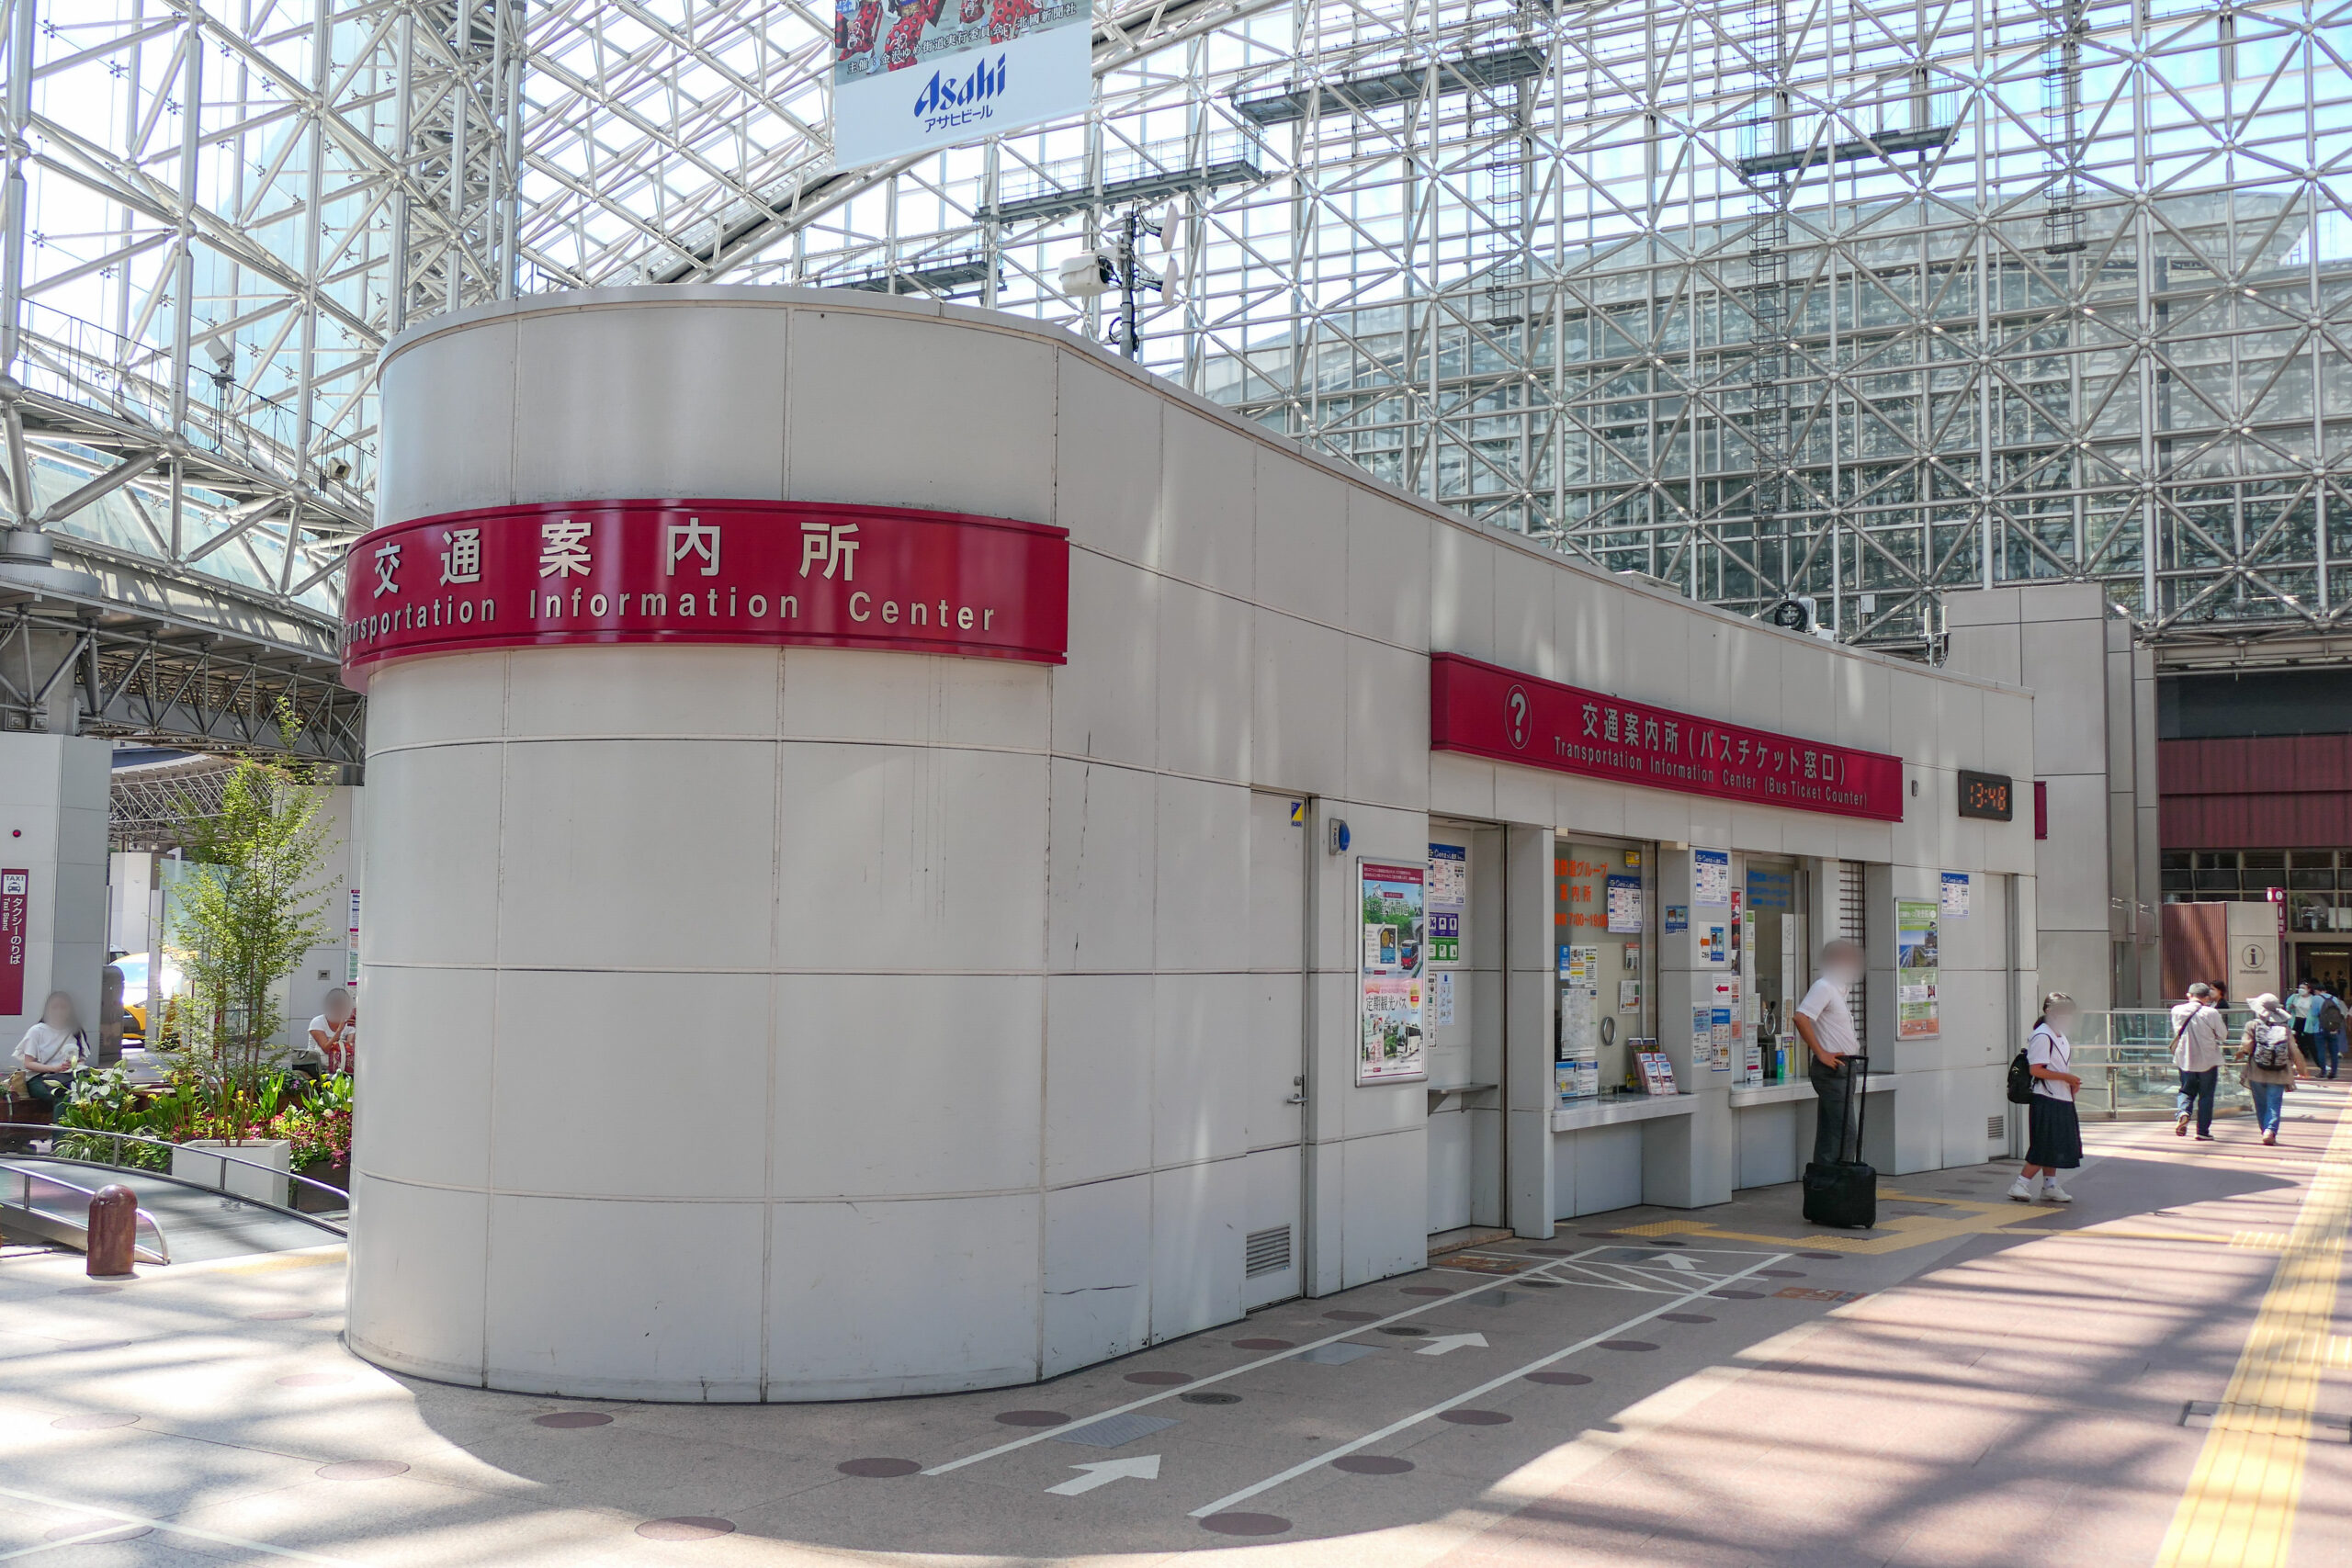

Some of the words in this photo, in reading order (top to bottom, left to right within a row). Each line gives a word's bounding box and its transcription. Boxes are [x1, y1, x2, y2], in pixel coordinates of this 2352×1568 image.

[914, 52, 1005, 118] Asahi
[925, 105, 993, 133] アサヒビール
[373, 517, 860, 599] 交通案内所
[343, 595, 495, 646] ransportation
[530, 587, 797, 619] Information
[849, 591, 995, 631] Center
[1555, 736, 1642, 771] Transportation
[1650, 756, 1713, 783] Information
[1723, 769, 1757, 790] Center
[1765, 776, 1787, 795] (Bus
[1792, 780, 1821, 800] Ticket
[1826, 786, 1867, 808] Counter)
[1970, 783, 2007, 811] 13:48
[11, 897, 23, 964] タクシーのりば
[1365, 995, 1408, 1012] 定期観光バス
